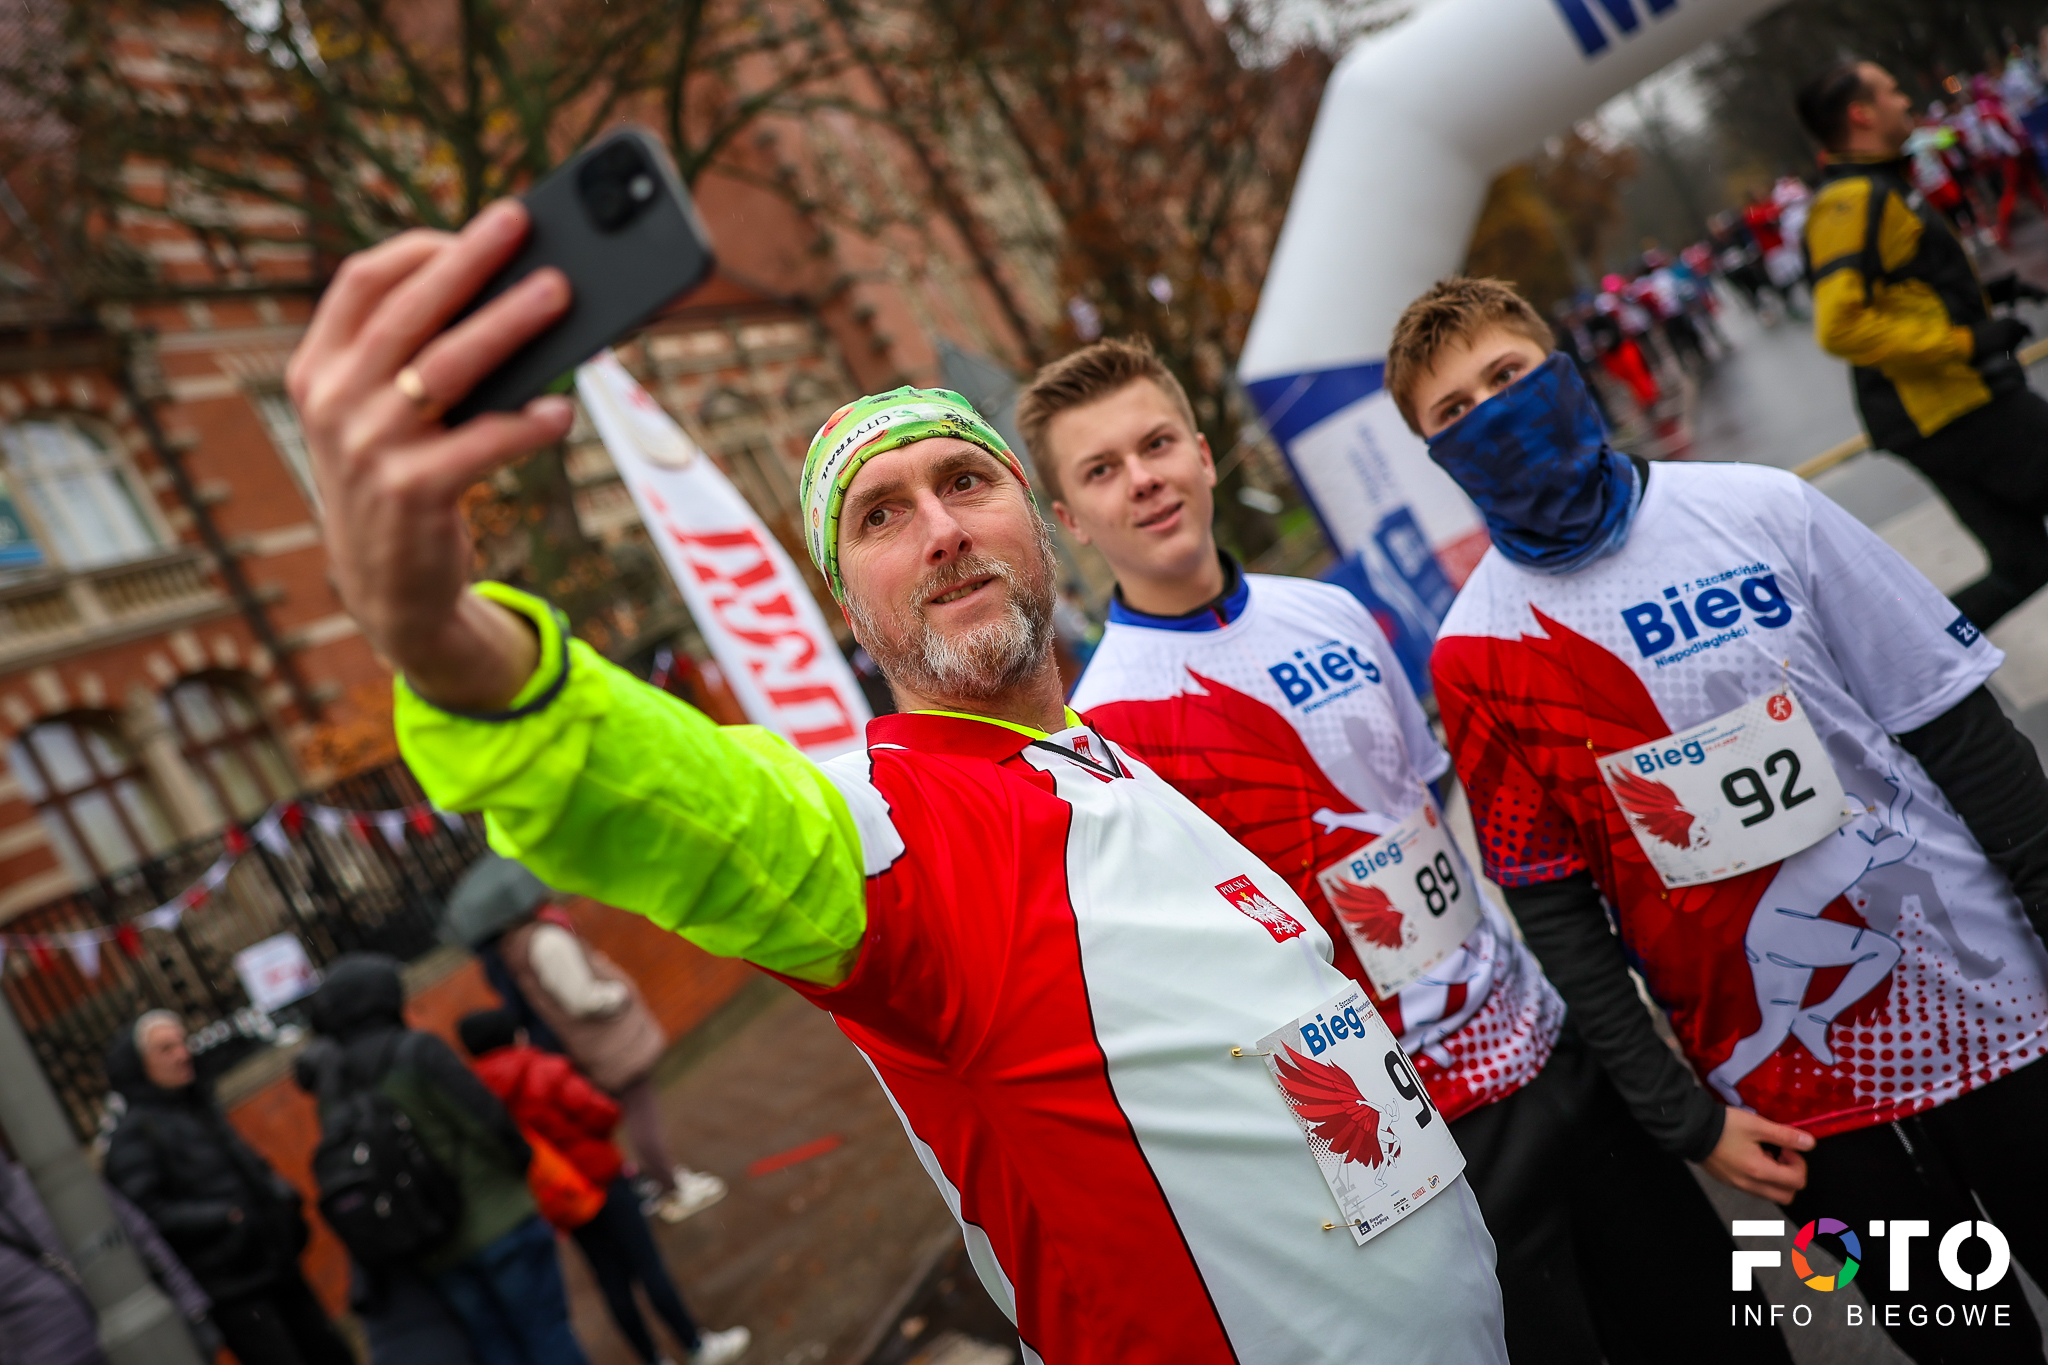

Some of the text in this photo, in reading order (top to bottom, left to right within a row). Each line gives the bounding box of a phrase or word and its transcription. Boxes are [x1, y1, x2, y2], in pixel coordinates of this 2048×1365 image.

[1620, 574, 1792, 658] Bieg
[1268, 646, 1381, 706] Bieg
[1634, 740, 1706, 775] Bieg
[1720, 748, 1817, 828] 92
[1351, 843, 1403, 880] Bieg
[1415, 851, 1462, 918] 89
[1299, 1005, 1366, 1057] Bieg
